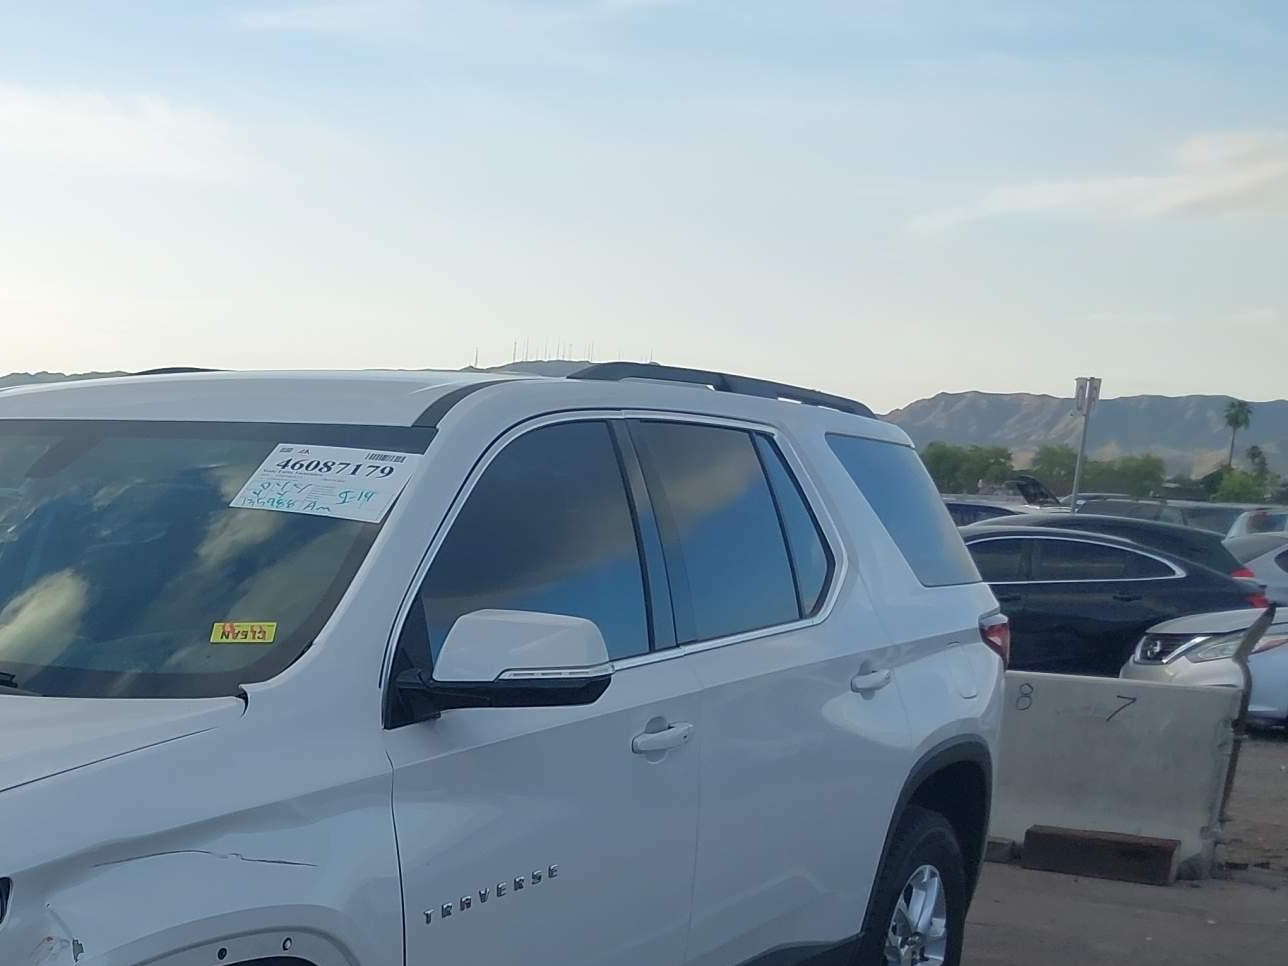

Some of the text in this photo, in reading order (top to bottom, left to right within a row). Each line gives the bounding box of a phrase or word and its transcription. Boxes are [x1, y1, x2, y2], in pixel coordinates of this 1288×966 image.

[276, 457, 394, 479] 46087179
[1015, 682, 1137, 722] 8 7
[423, 864, 559, 925] TRAVERSE
